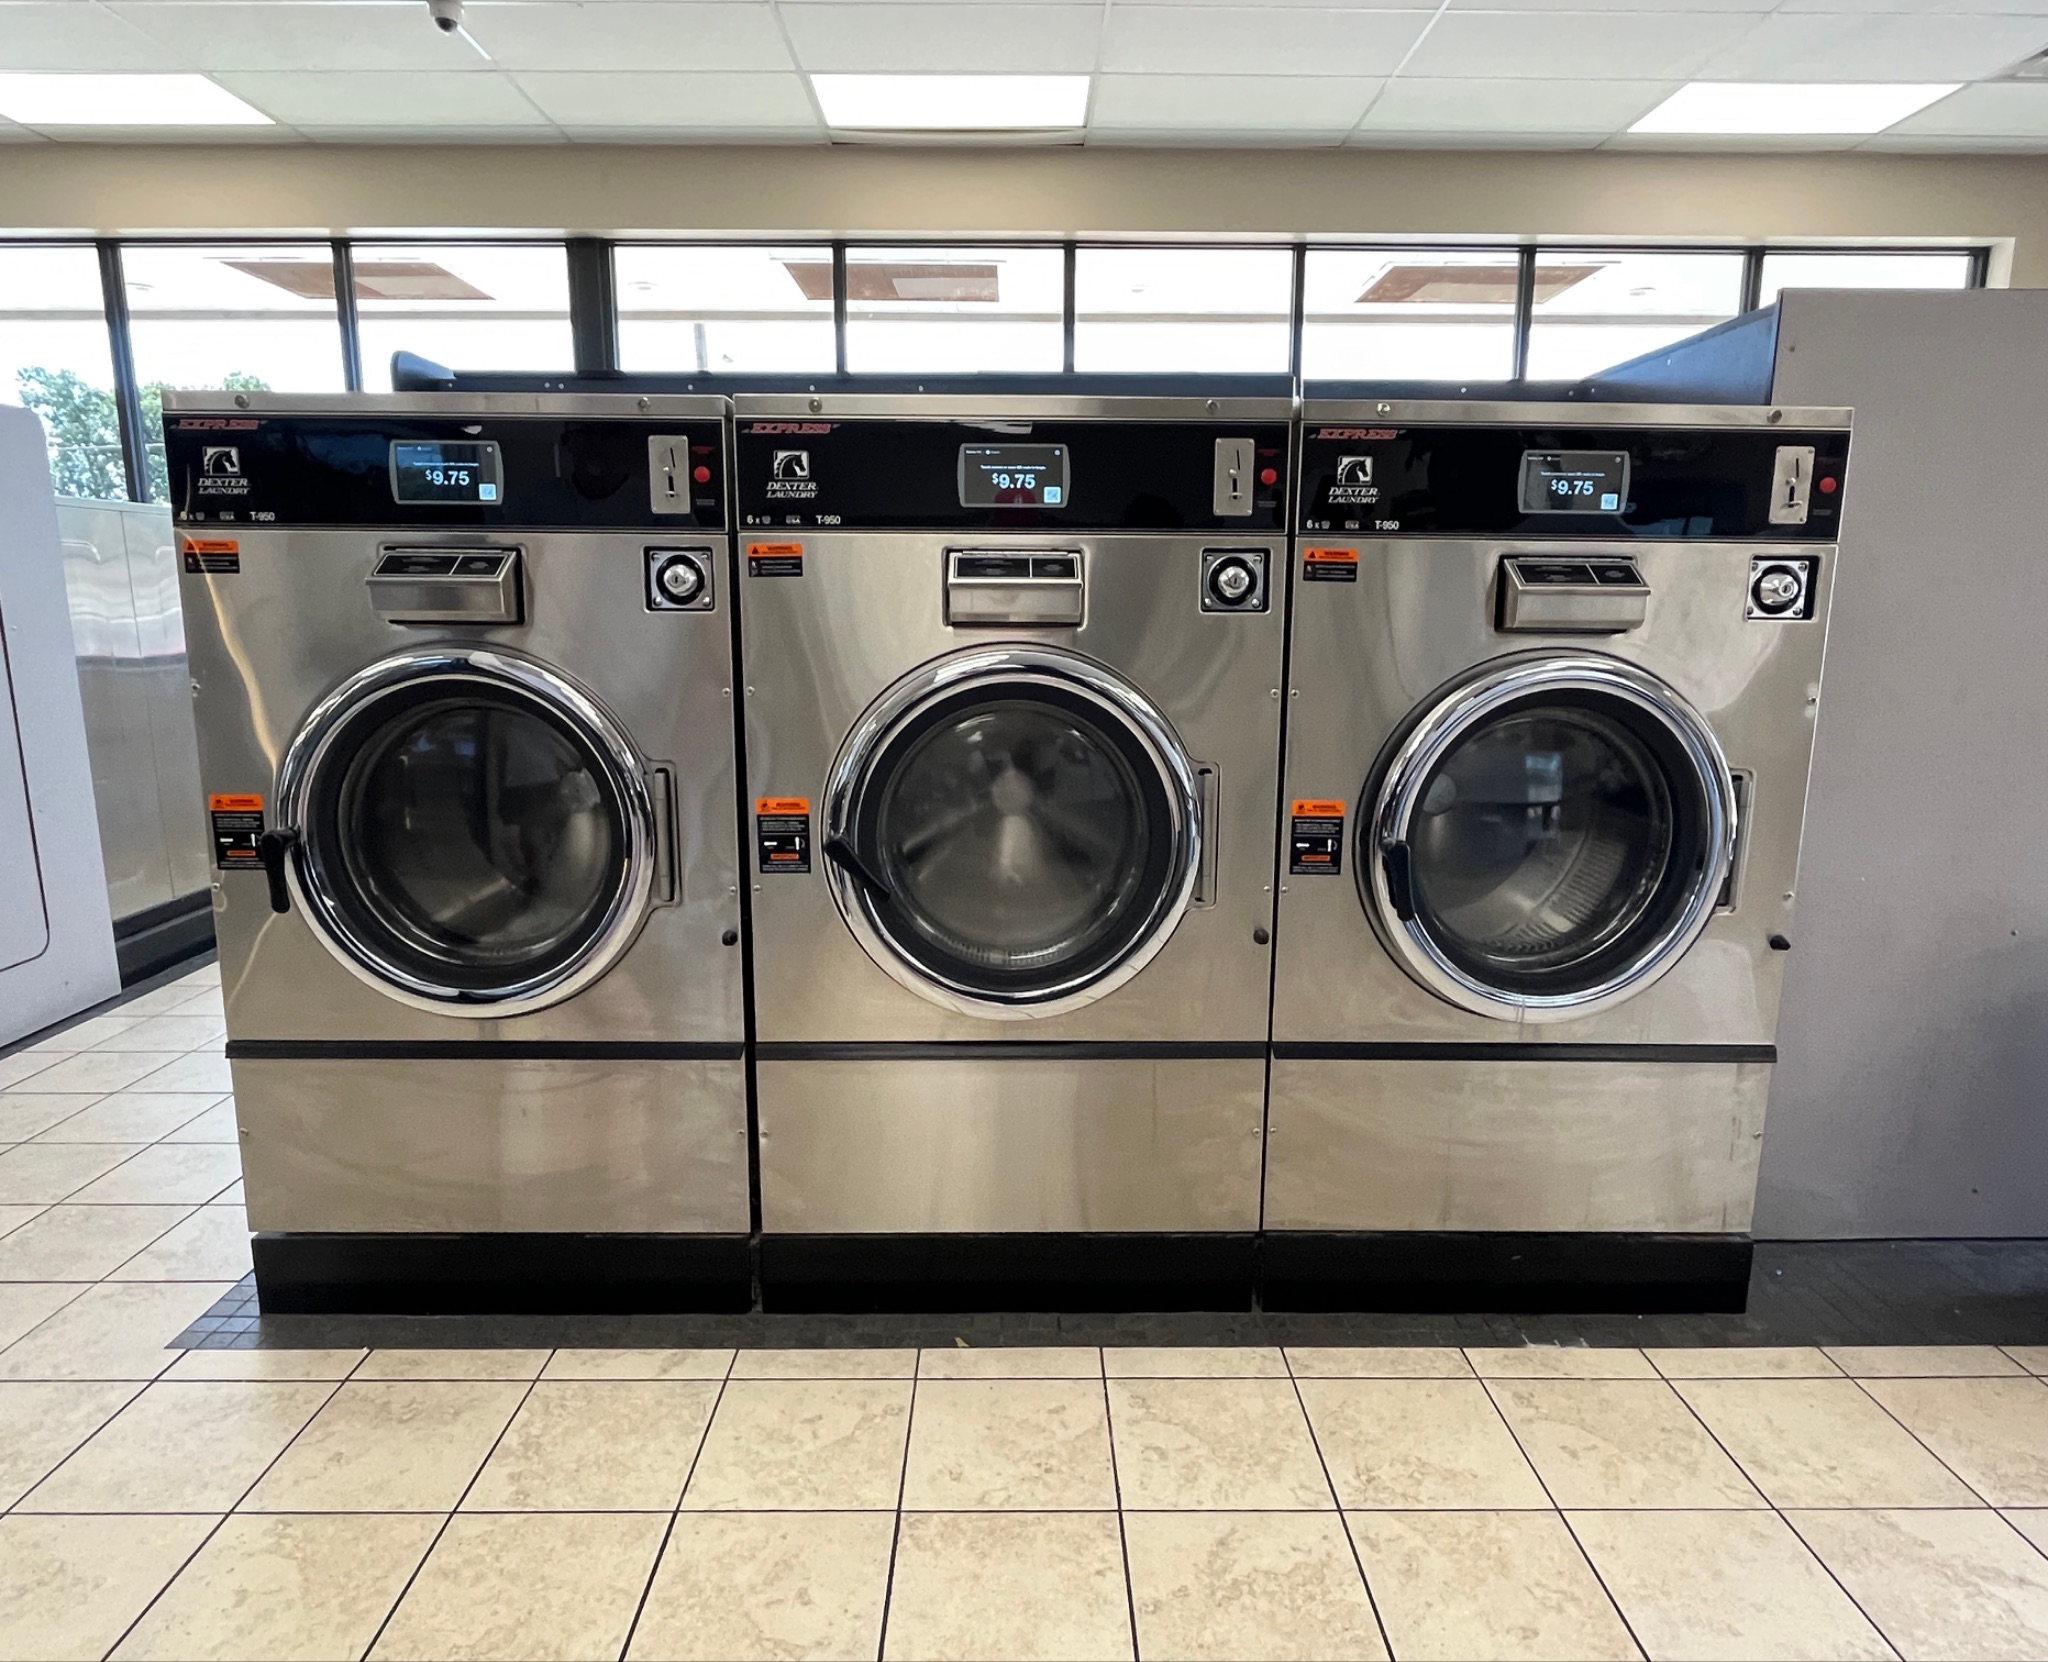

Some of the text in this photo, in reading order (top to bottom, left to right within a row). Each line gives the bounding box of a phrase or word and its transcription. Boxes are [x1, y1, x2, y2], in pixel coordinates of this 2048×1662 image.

[751, 422, 832, 434] EXPRESS
[1317, 428, 1398, 440] EXPRESS
[197, 478, 248, 487] DEXTER
[425, 469, 470, 486] $9.75
[992, 472, 1036, 489] $9.75
[766, 481, 817, 490] DEXTER
[1550, 479, 1594, 495] $9.75
[198, 487, 250, 495] LAUNDRY
[766, 491, 818, 499] LAUNDRY
[1328, 487, 1378, 496] DEXTER
[1328, 496, 1380, 504] LAUNDRY
[249, 511, 276, 521] T-950
[747, 515, 754, 525] 6
[815, 515, 841, 525] T-950
[1306, 519, 1313, 529] 6
[1374, 520, 1400, 530] T-950
